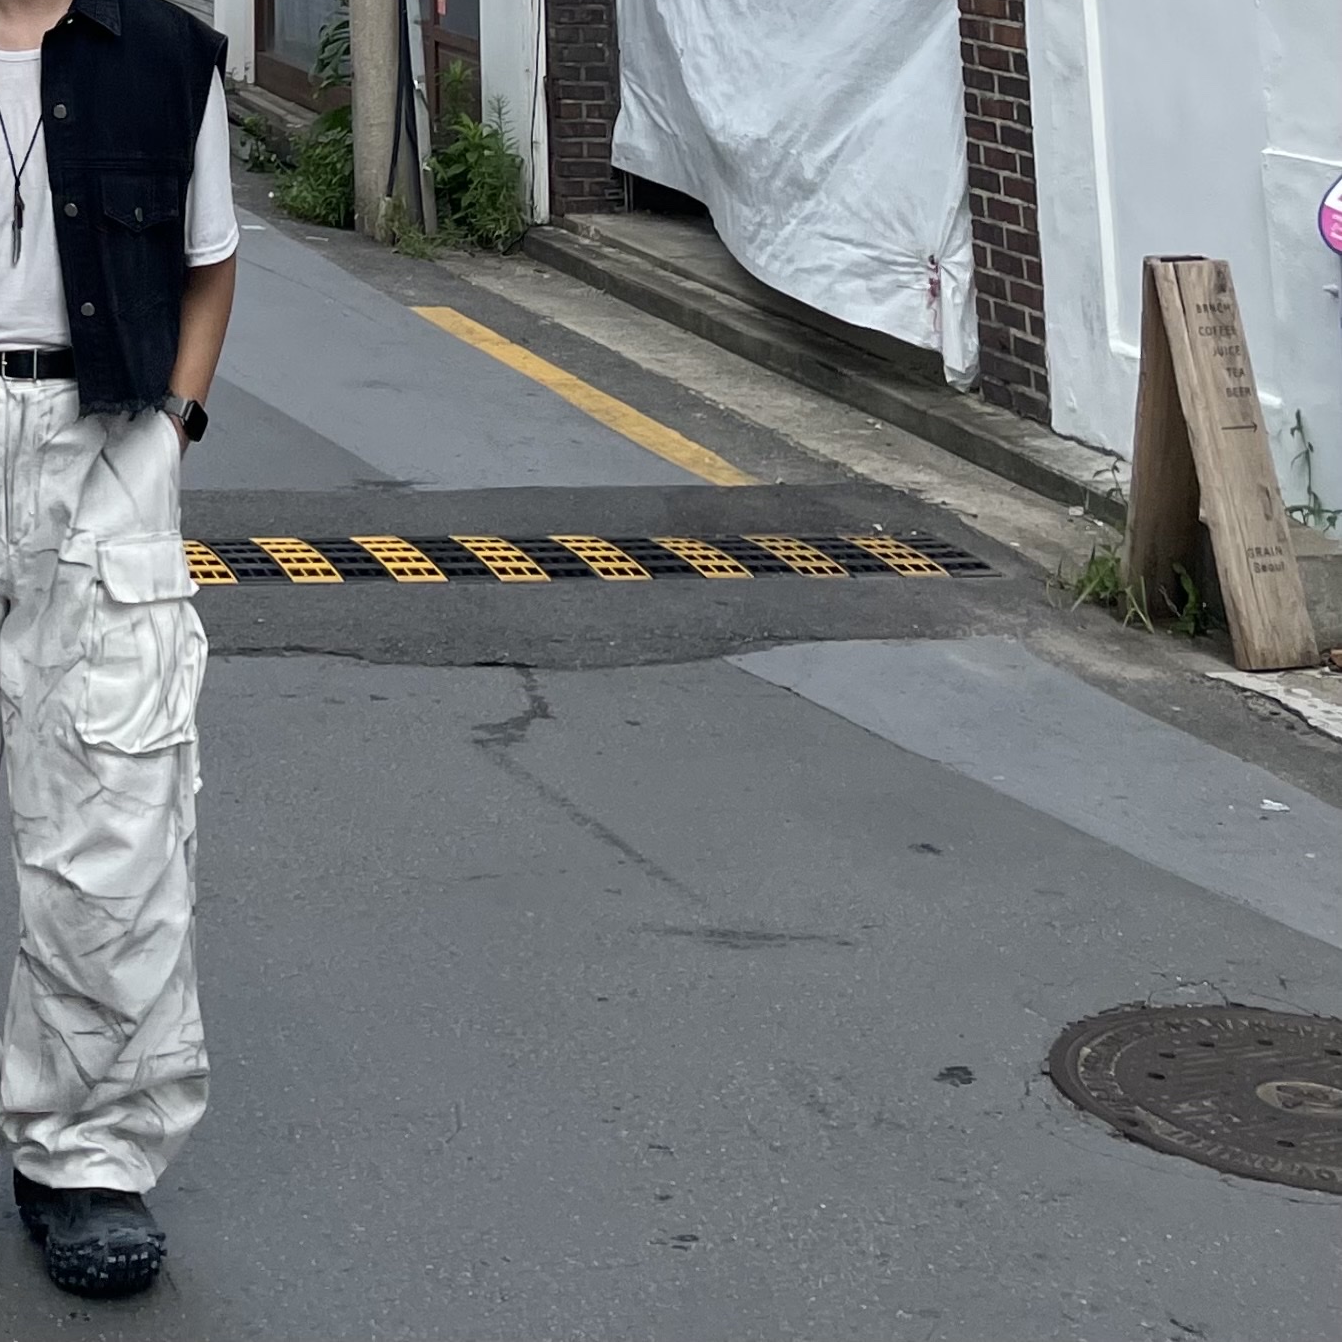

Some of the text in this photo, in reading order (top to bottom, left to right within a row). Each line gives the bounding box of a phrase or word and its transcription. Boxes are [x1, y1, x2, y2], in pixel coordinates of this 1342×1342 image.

[1213, 345, 1241, 357] JUICE
[1226, 367, 1245, 378] TEA
[1226, 387, 1251, 398] BEER
